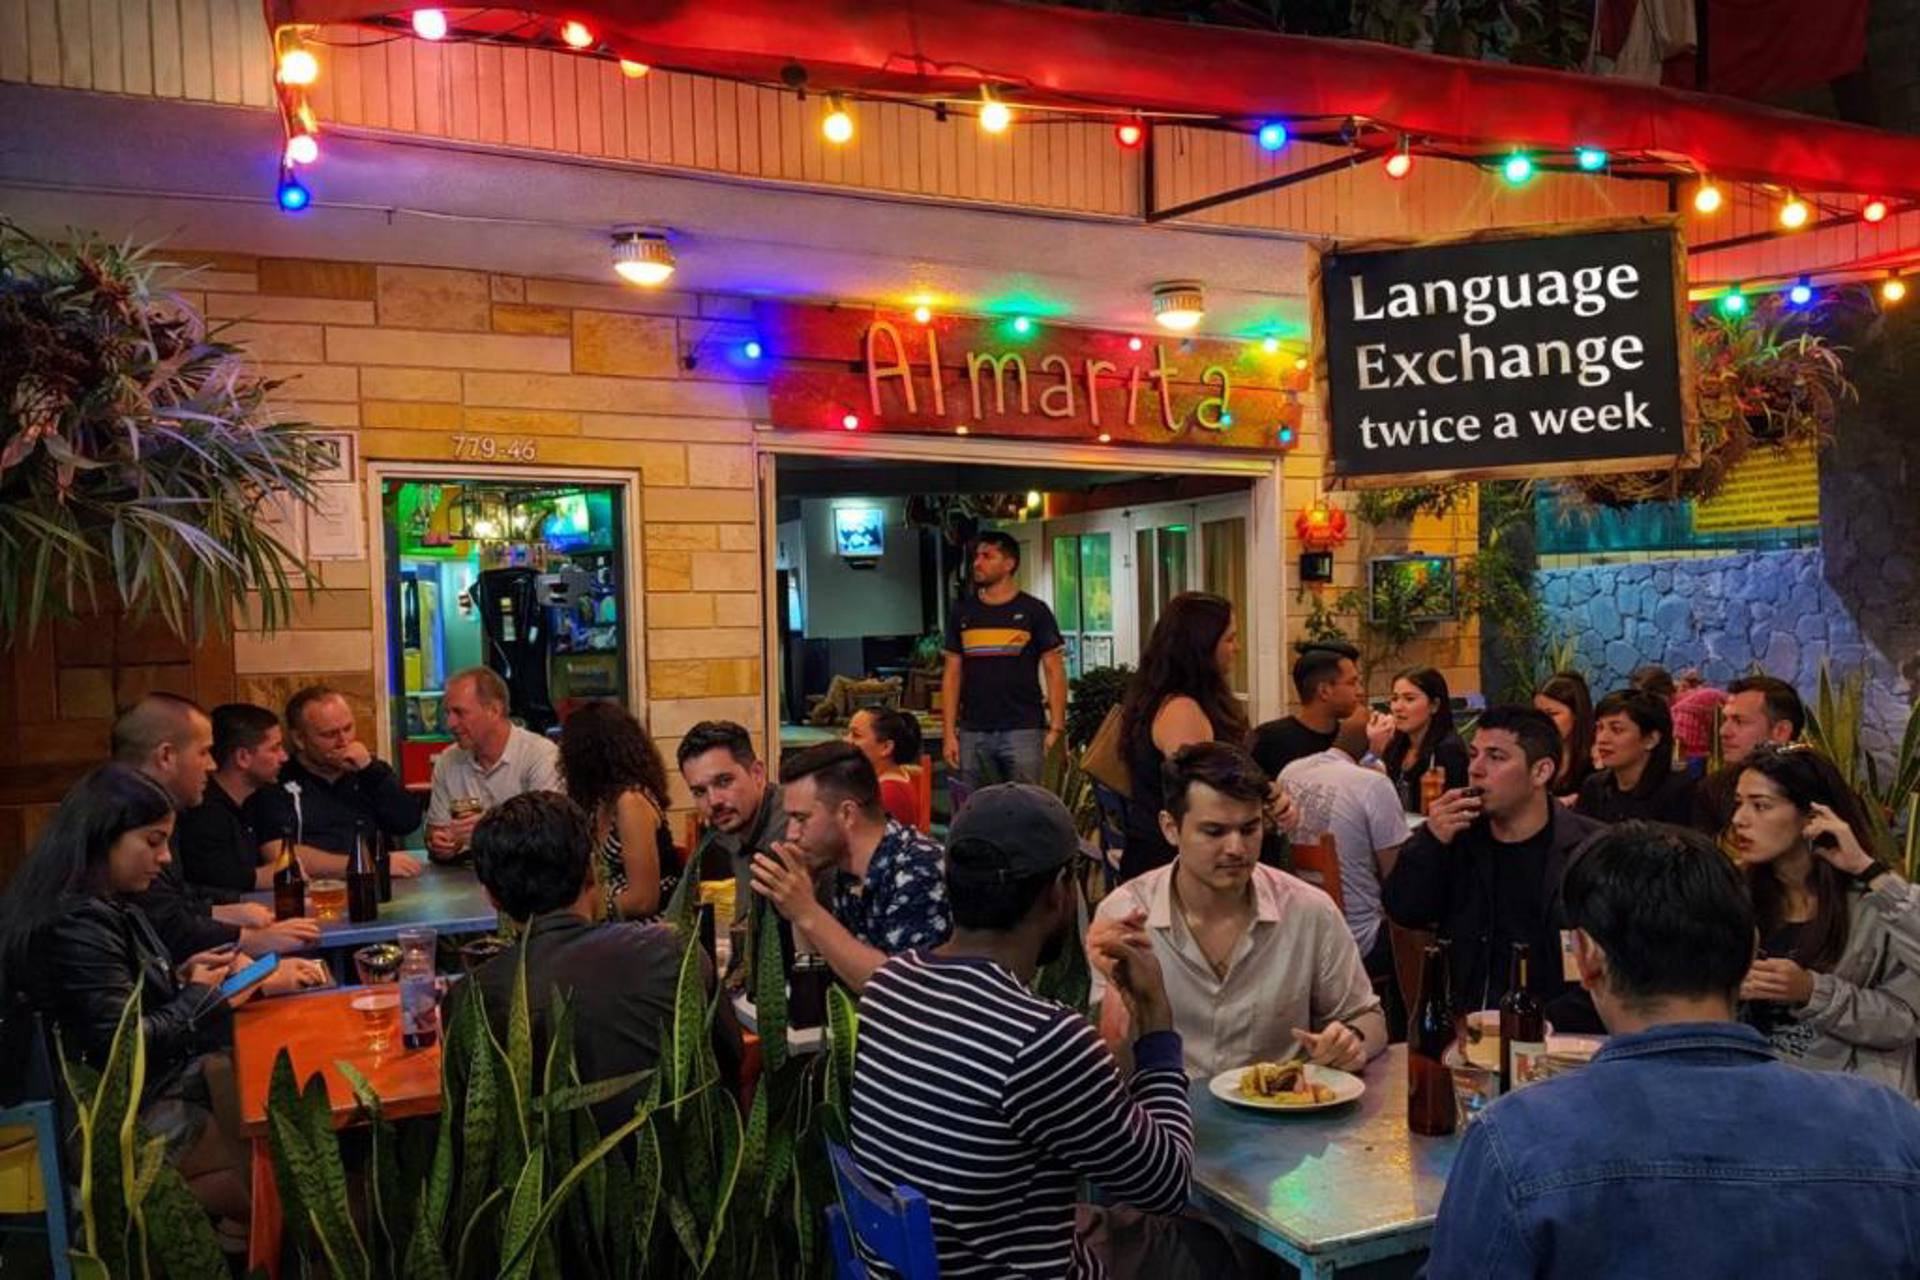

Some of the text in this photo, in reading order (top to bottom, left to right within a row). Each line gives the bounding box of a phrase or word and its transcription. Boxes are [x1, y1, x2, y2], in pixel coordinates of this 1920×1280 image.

[1350, 262, 1640, 327] Language
[866, 319, 1231, 434] Almarita
[1355, 332, 1645, 389] Exchange
[450, 434, 537, 461] 779-46
[1358, 391, 1653, 450] twice a week
